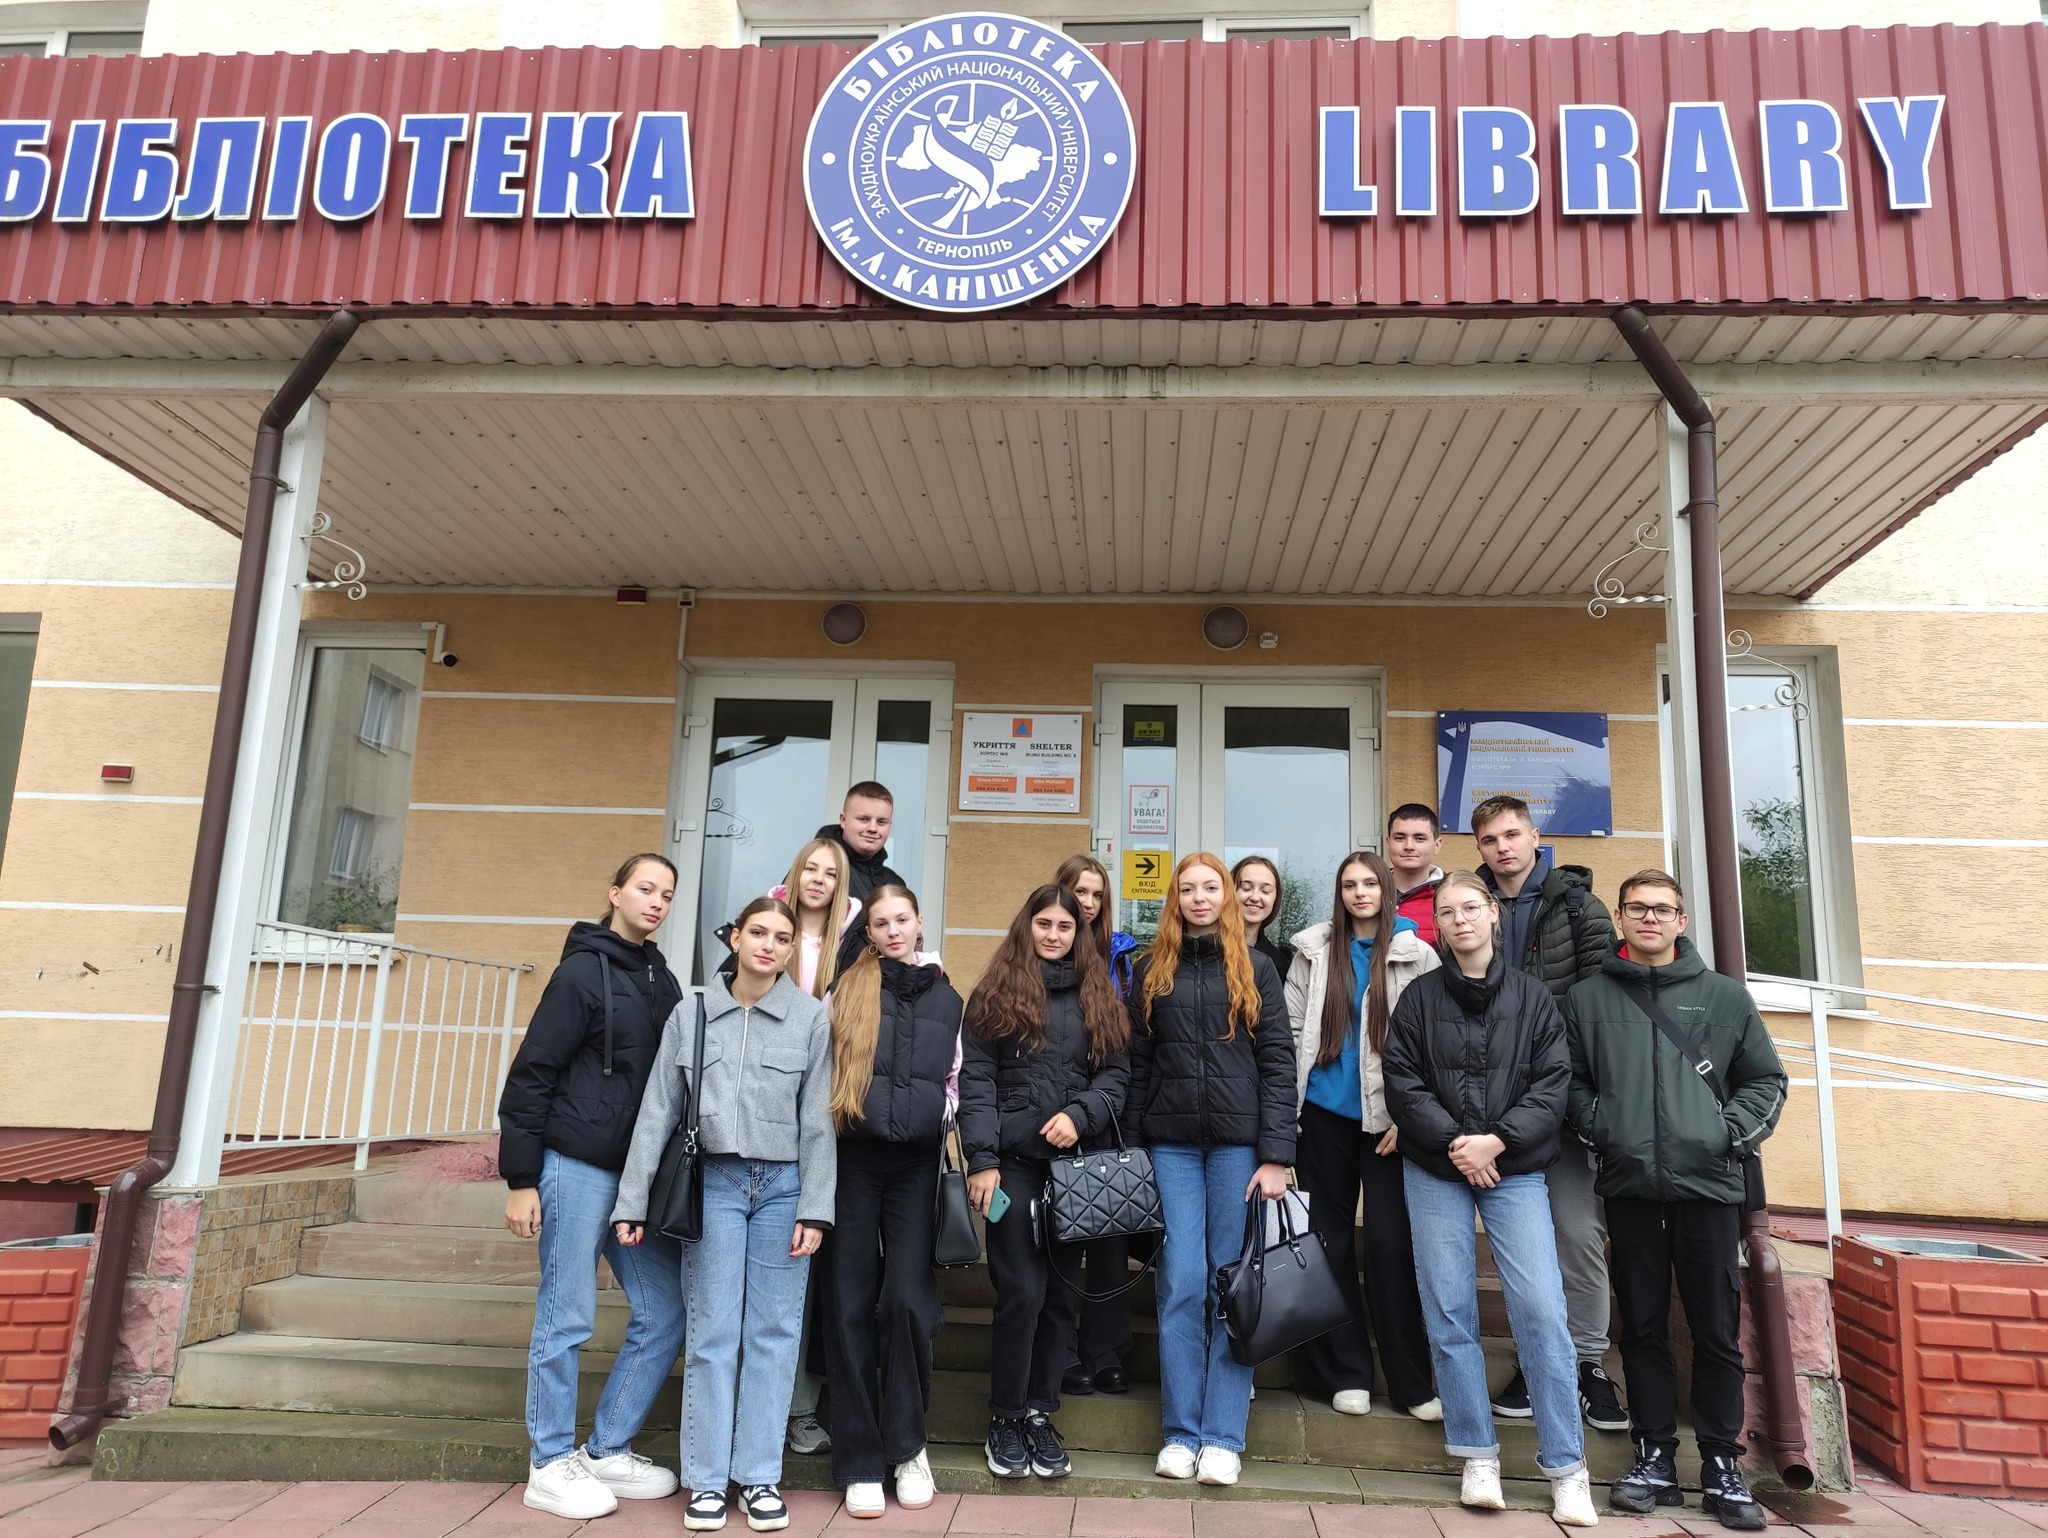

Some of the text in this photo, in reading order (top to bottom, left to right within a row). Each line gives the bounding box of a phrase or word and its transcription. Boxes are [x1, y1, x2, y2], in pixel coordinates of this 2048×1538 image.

[843, 22, 1100, 103] БІБЛІОТЕКА
[0, 111, 697, 223] БІБЛІОТЕКА
[859, 61, 1079, 223] ЗАХІДНОУКРАЇНСЬКИЙ НАЦІОНАЛЬНИЙ УНІВЕРСИТЕТ
[1318, 94, 1947, 217] LIBRARY
[915, 235, 1014, 259] ТЕРНОПІЛЬ
[972, 741, 1016, 749] УКРИТТЯ
[1029, 743, 1073, 751] SHELTER
[1133, 808, 1166, 817] УВАГА!
